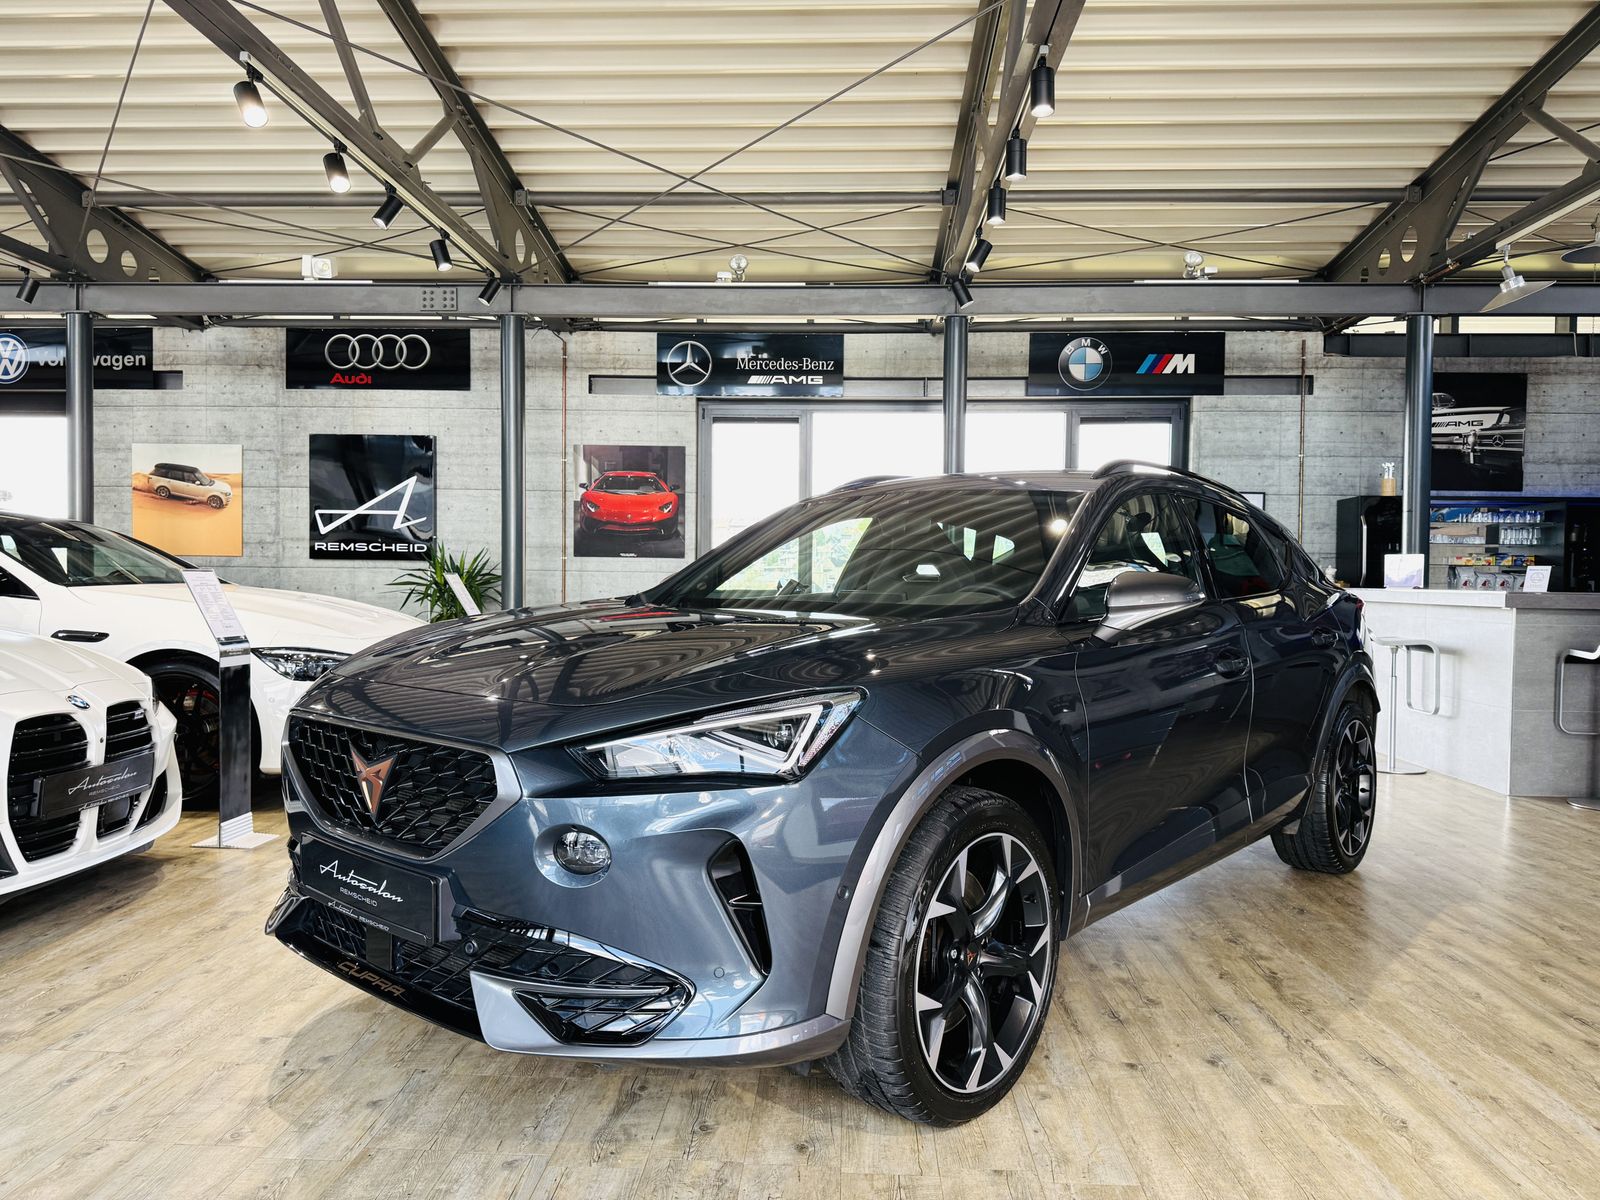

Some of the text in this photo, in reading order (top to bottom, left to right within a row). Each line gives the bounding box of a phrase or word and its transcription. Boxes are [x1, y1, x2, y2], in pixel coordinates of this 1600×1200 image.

[1064, 338, 1108, 355] BMW
[736, 357, 835, 371] Mercedes-Benz
[330, 372, 372, 385] Audi
[769, 375, 824, 385] AMG
[1445, 419, 1484, 428] AMG
[314, 542, 428, 553] REMSCHEID
[319, 859, 404, 903] Autosalon
[340, 886, 378, 907] REMSCHEID
[337, 961, 406, 997] CUPRA
